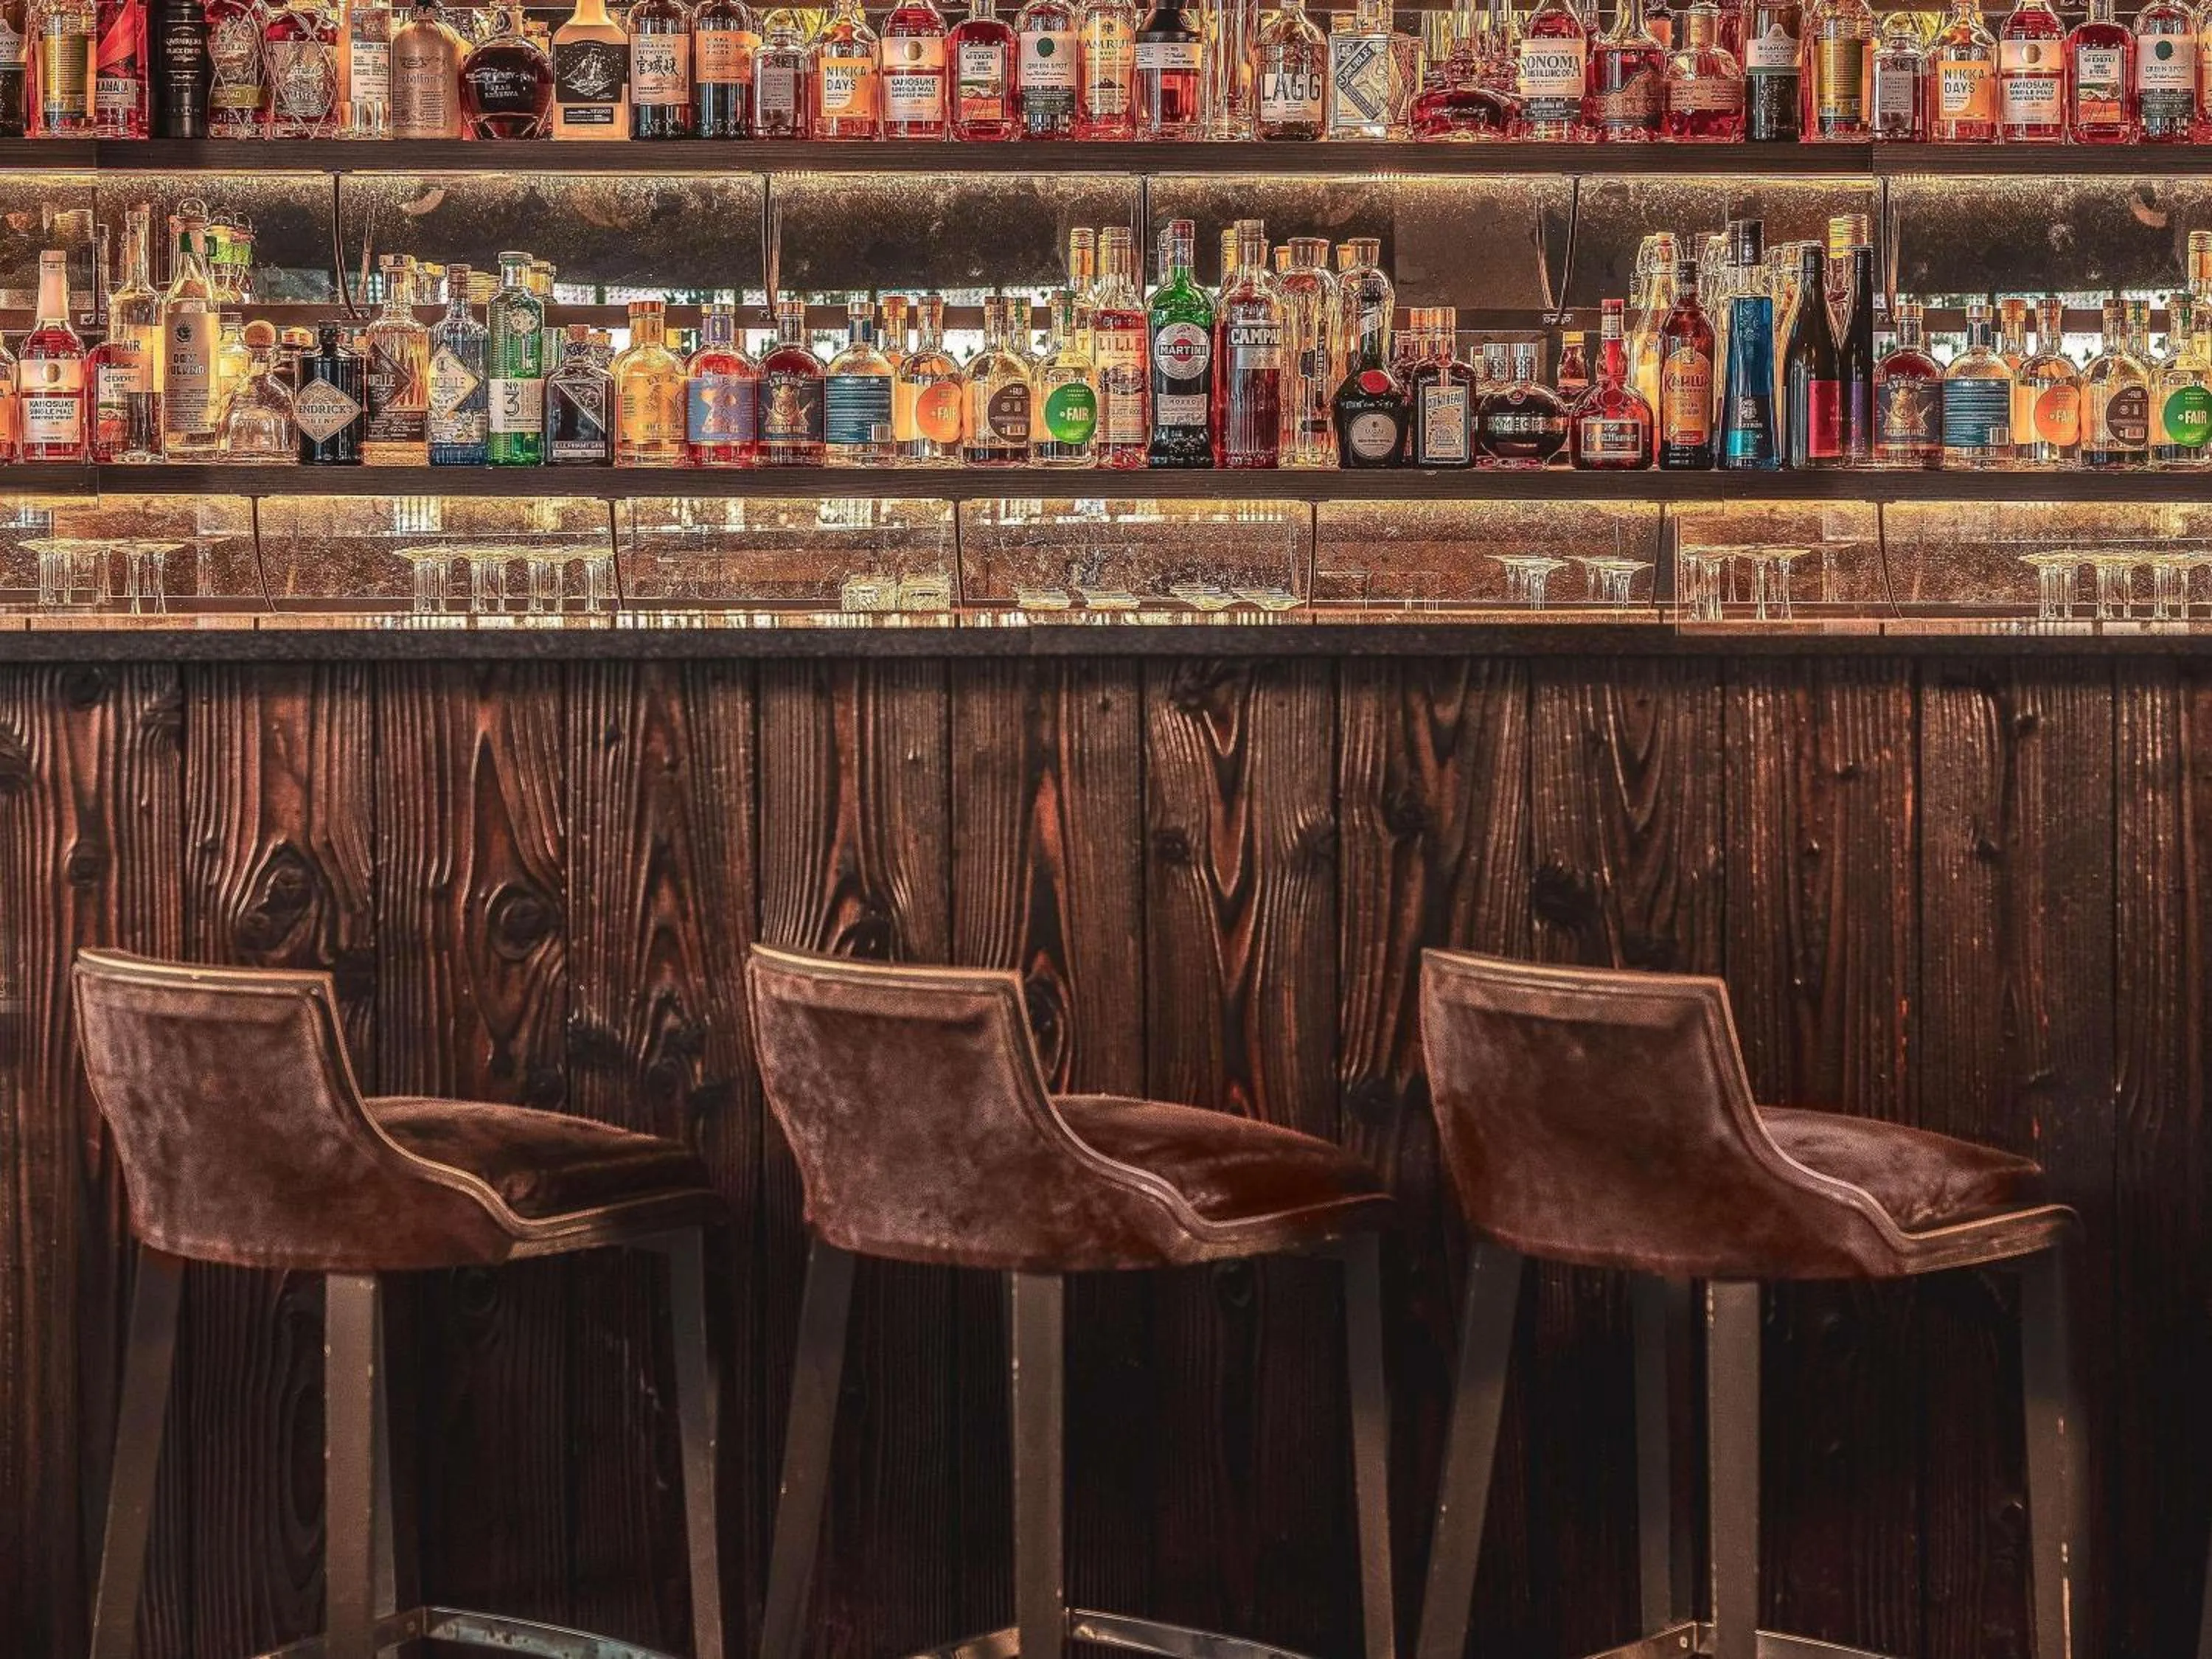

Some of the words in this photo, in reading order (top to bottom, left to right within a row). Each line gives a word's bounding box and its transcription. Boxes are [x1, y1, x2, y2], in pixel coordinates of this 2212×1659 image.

[1085, 39, 1130, 49] AMRUT
[827, 65, 866, 77] NIKKA
[1521, 55, 1582, 78] SONOMA
[1944, 69, 1984, 80] NIKKA
[827, 79, 857, 91] DAYS
[891, 77, 937, 86] KANOSUKE
[1262, 74, 1321, 101] LAGG
[2009, 81, 2055, 89] KANOSUKE
[1944, 83, 1975, 94] DAYS
[1160, 344, 1206, 355] MARTINI
[504, 391, 520, 416] 3
[937, 406, 957, 422] FAIR
[1066, 406, 1089, 421] FAIR
[2055, 410, 2076, 423] FAIR
[2185, 411, 2208, 424] FAIR
